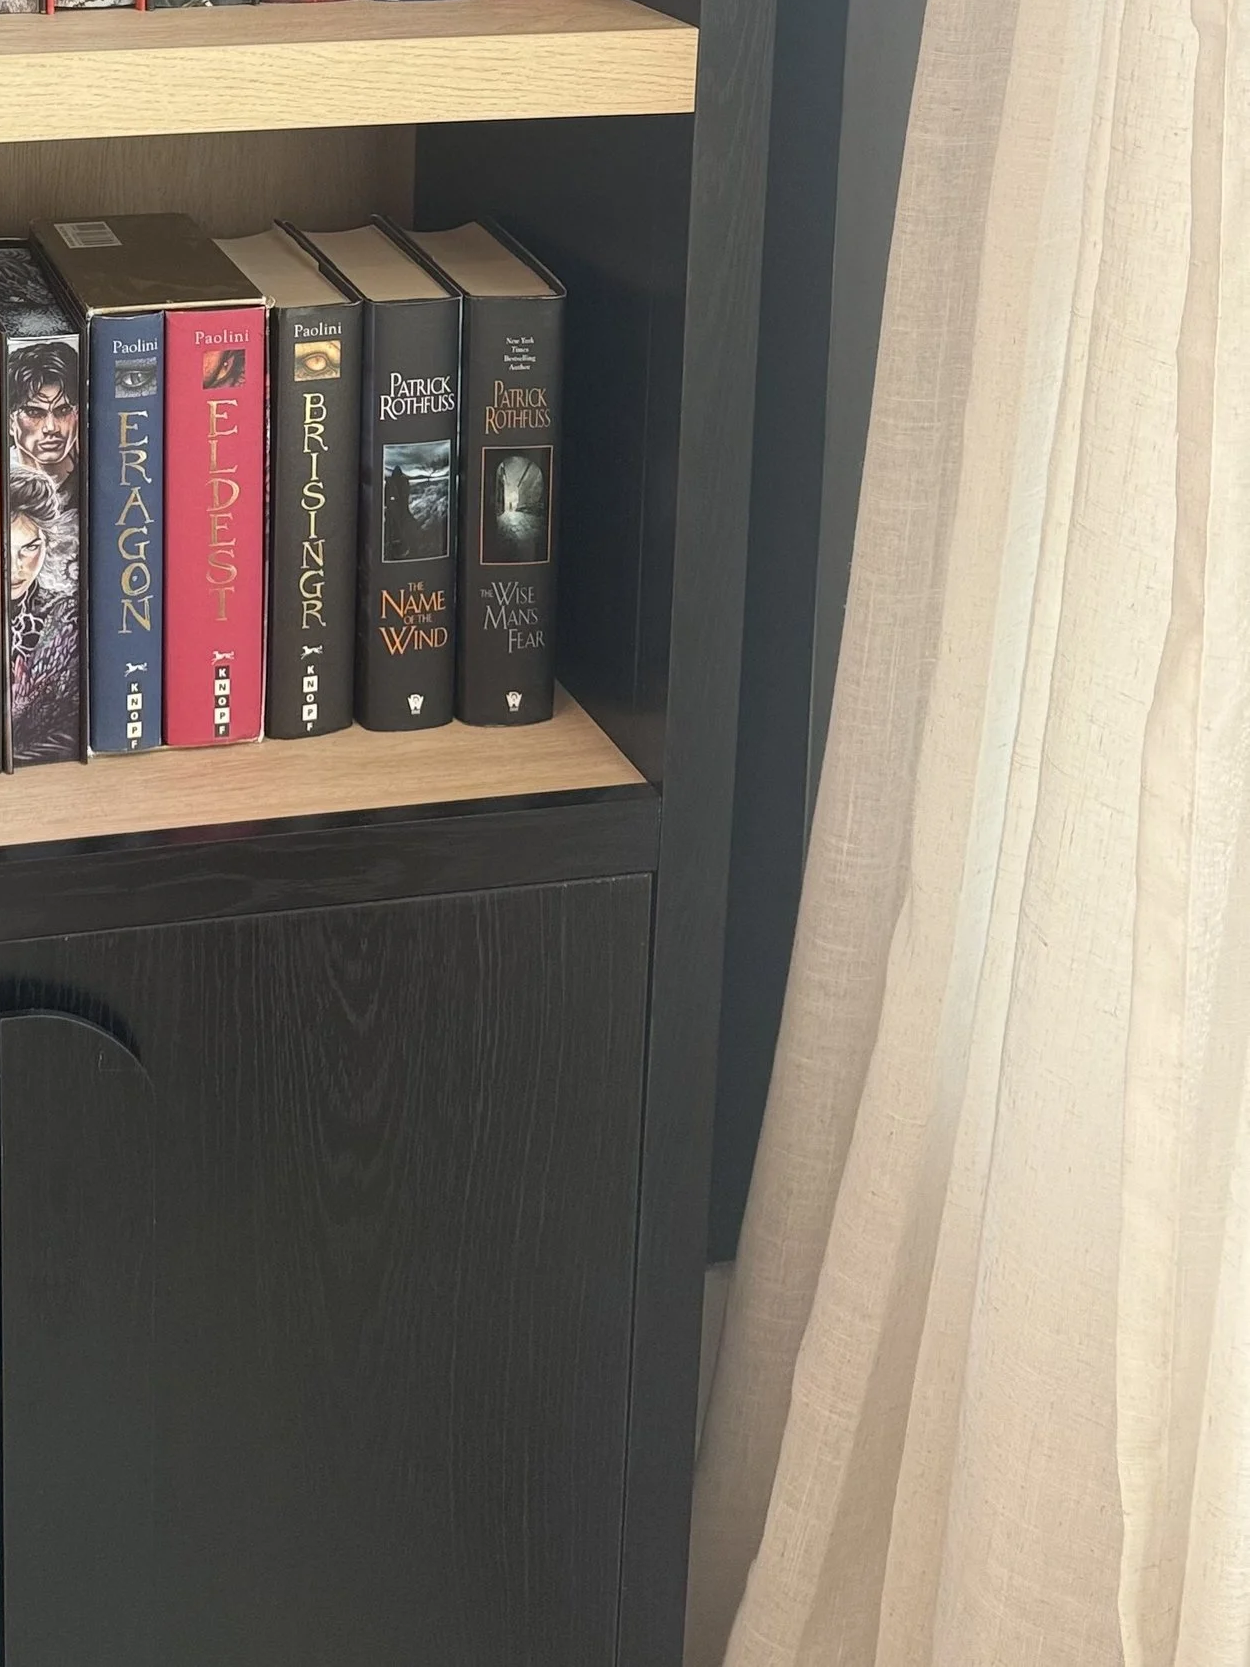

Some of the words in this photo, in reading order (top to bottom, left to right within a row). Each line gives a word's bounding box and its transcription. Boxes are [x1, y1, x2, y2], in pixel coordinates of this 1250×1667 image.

[195, 330, 249, 345] Paolini
[294, 323, 342, 338] Paolini
[113, 338, 158, 354] Paolini
[390, 372, 451, 398] PATRICK
[494, 380, 547, 408] PATRICK
[380, 393, 455, 420] ROTHFUSS
[485, 406, 550, 434] ROTHFUSS
[115, 410, 154, 634] ERAGON
[206, 399, 239, 621] ELDEST
[300, 393, 328, 629] BRISINGR
[408, 582, 424, 592] THE
[480, 589, 493, 598] THE
[491, 581, 535, 606] WISE
[380, 589, 446, 619] NAME
[417, 614, 433, 623] THE
[379, 626, 448, 655] WIND
[508, 628, 545, 654] FEAR
[216, 666, 229, 736] KNOPF
[304, 665, 317, 732] KNOPF
[128, 682, 142, 749] KNOPF
